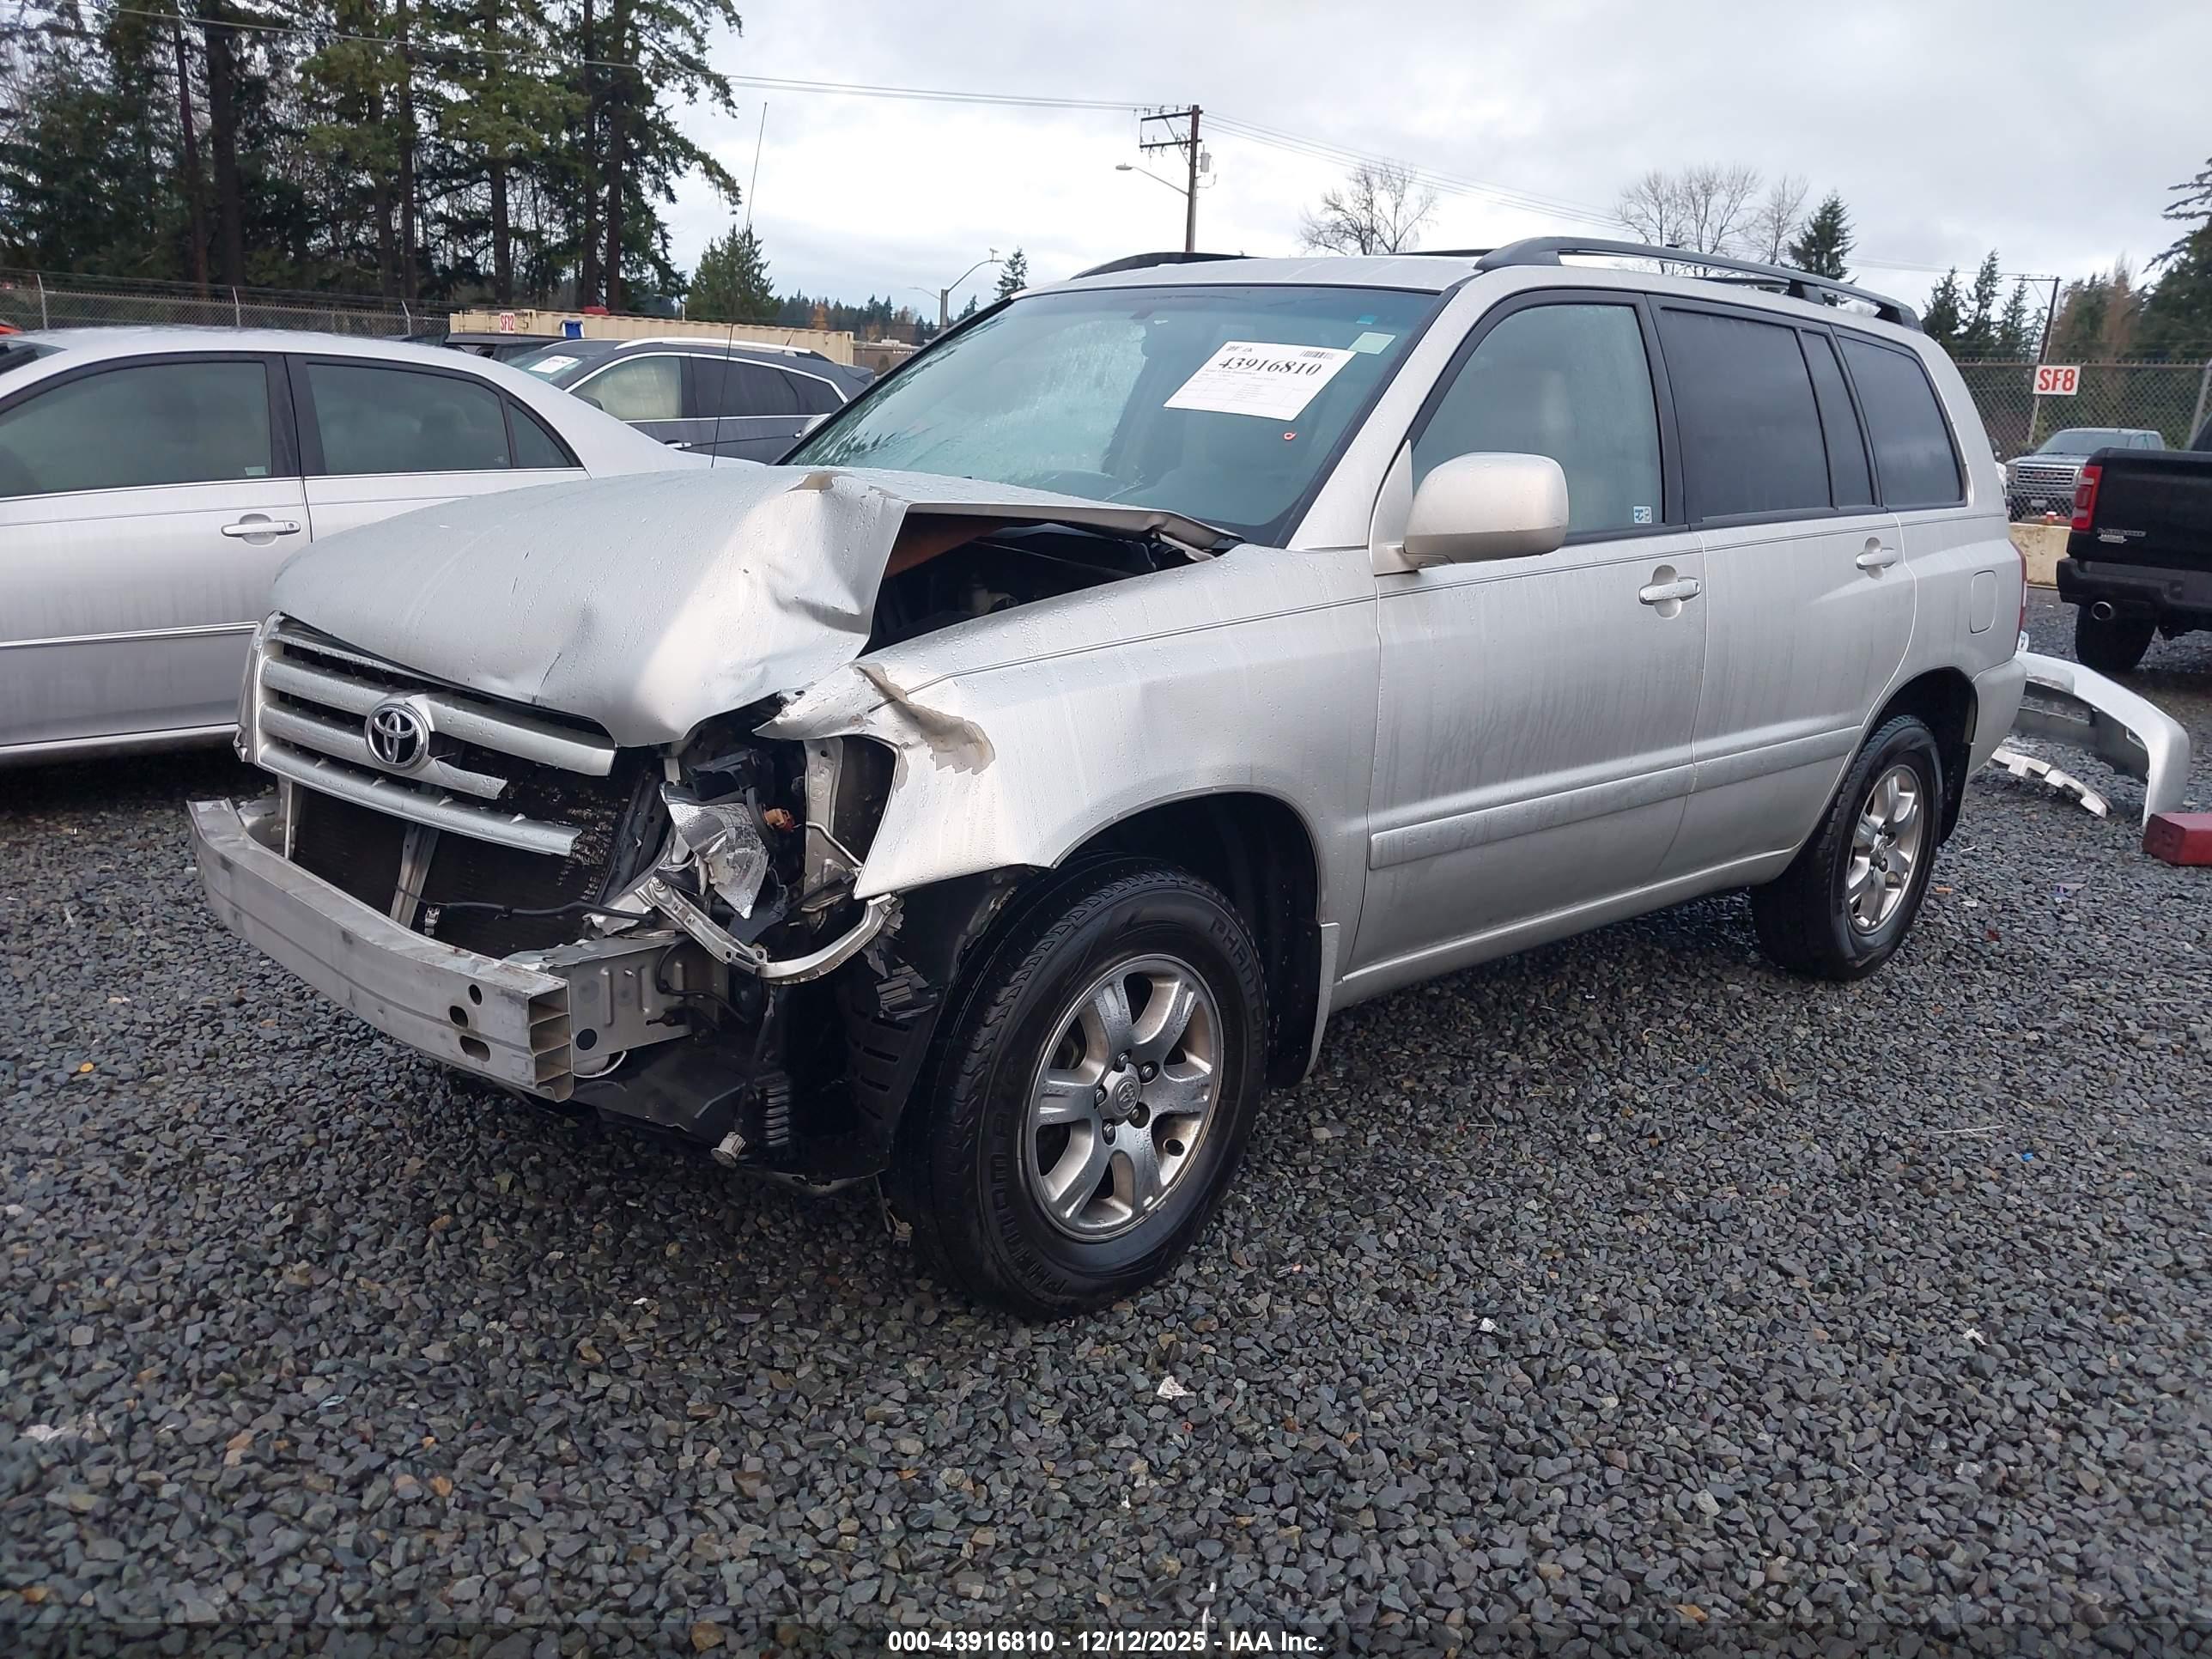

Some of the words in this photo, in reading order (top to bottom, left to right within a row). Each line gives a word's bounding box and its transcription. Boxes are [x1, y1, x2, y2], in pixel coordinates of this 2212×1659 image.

[501, 314, 514, 331] SF12
[1218, 356, 1322, 376] 43916810
[2038, 368, 2075, 392] SF8
